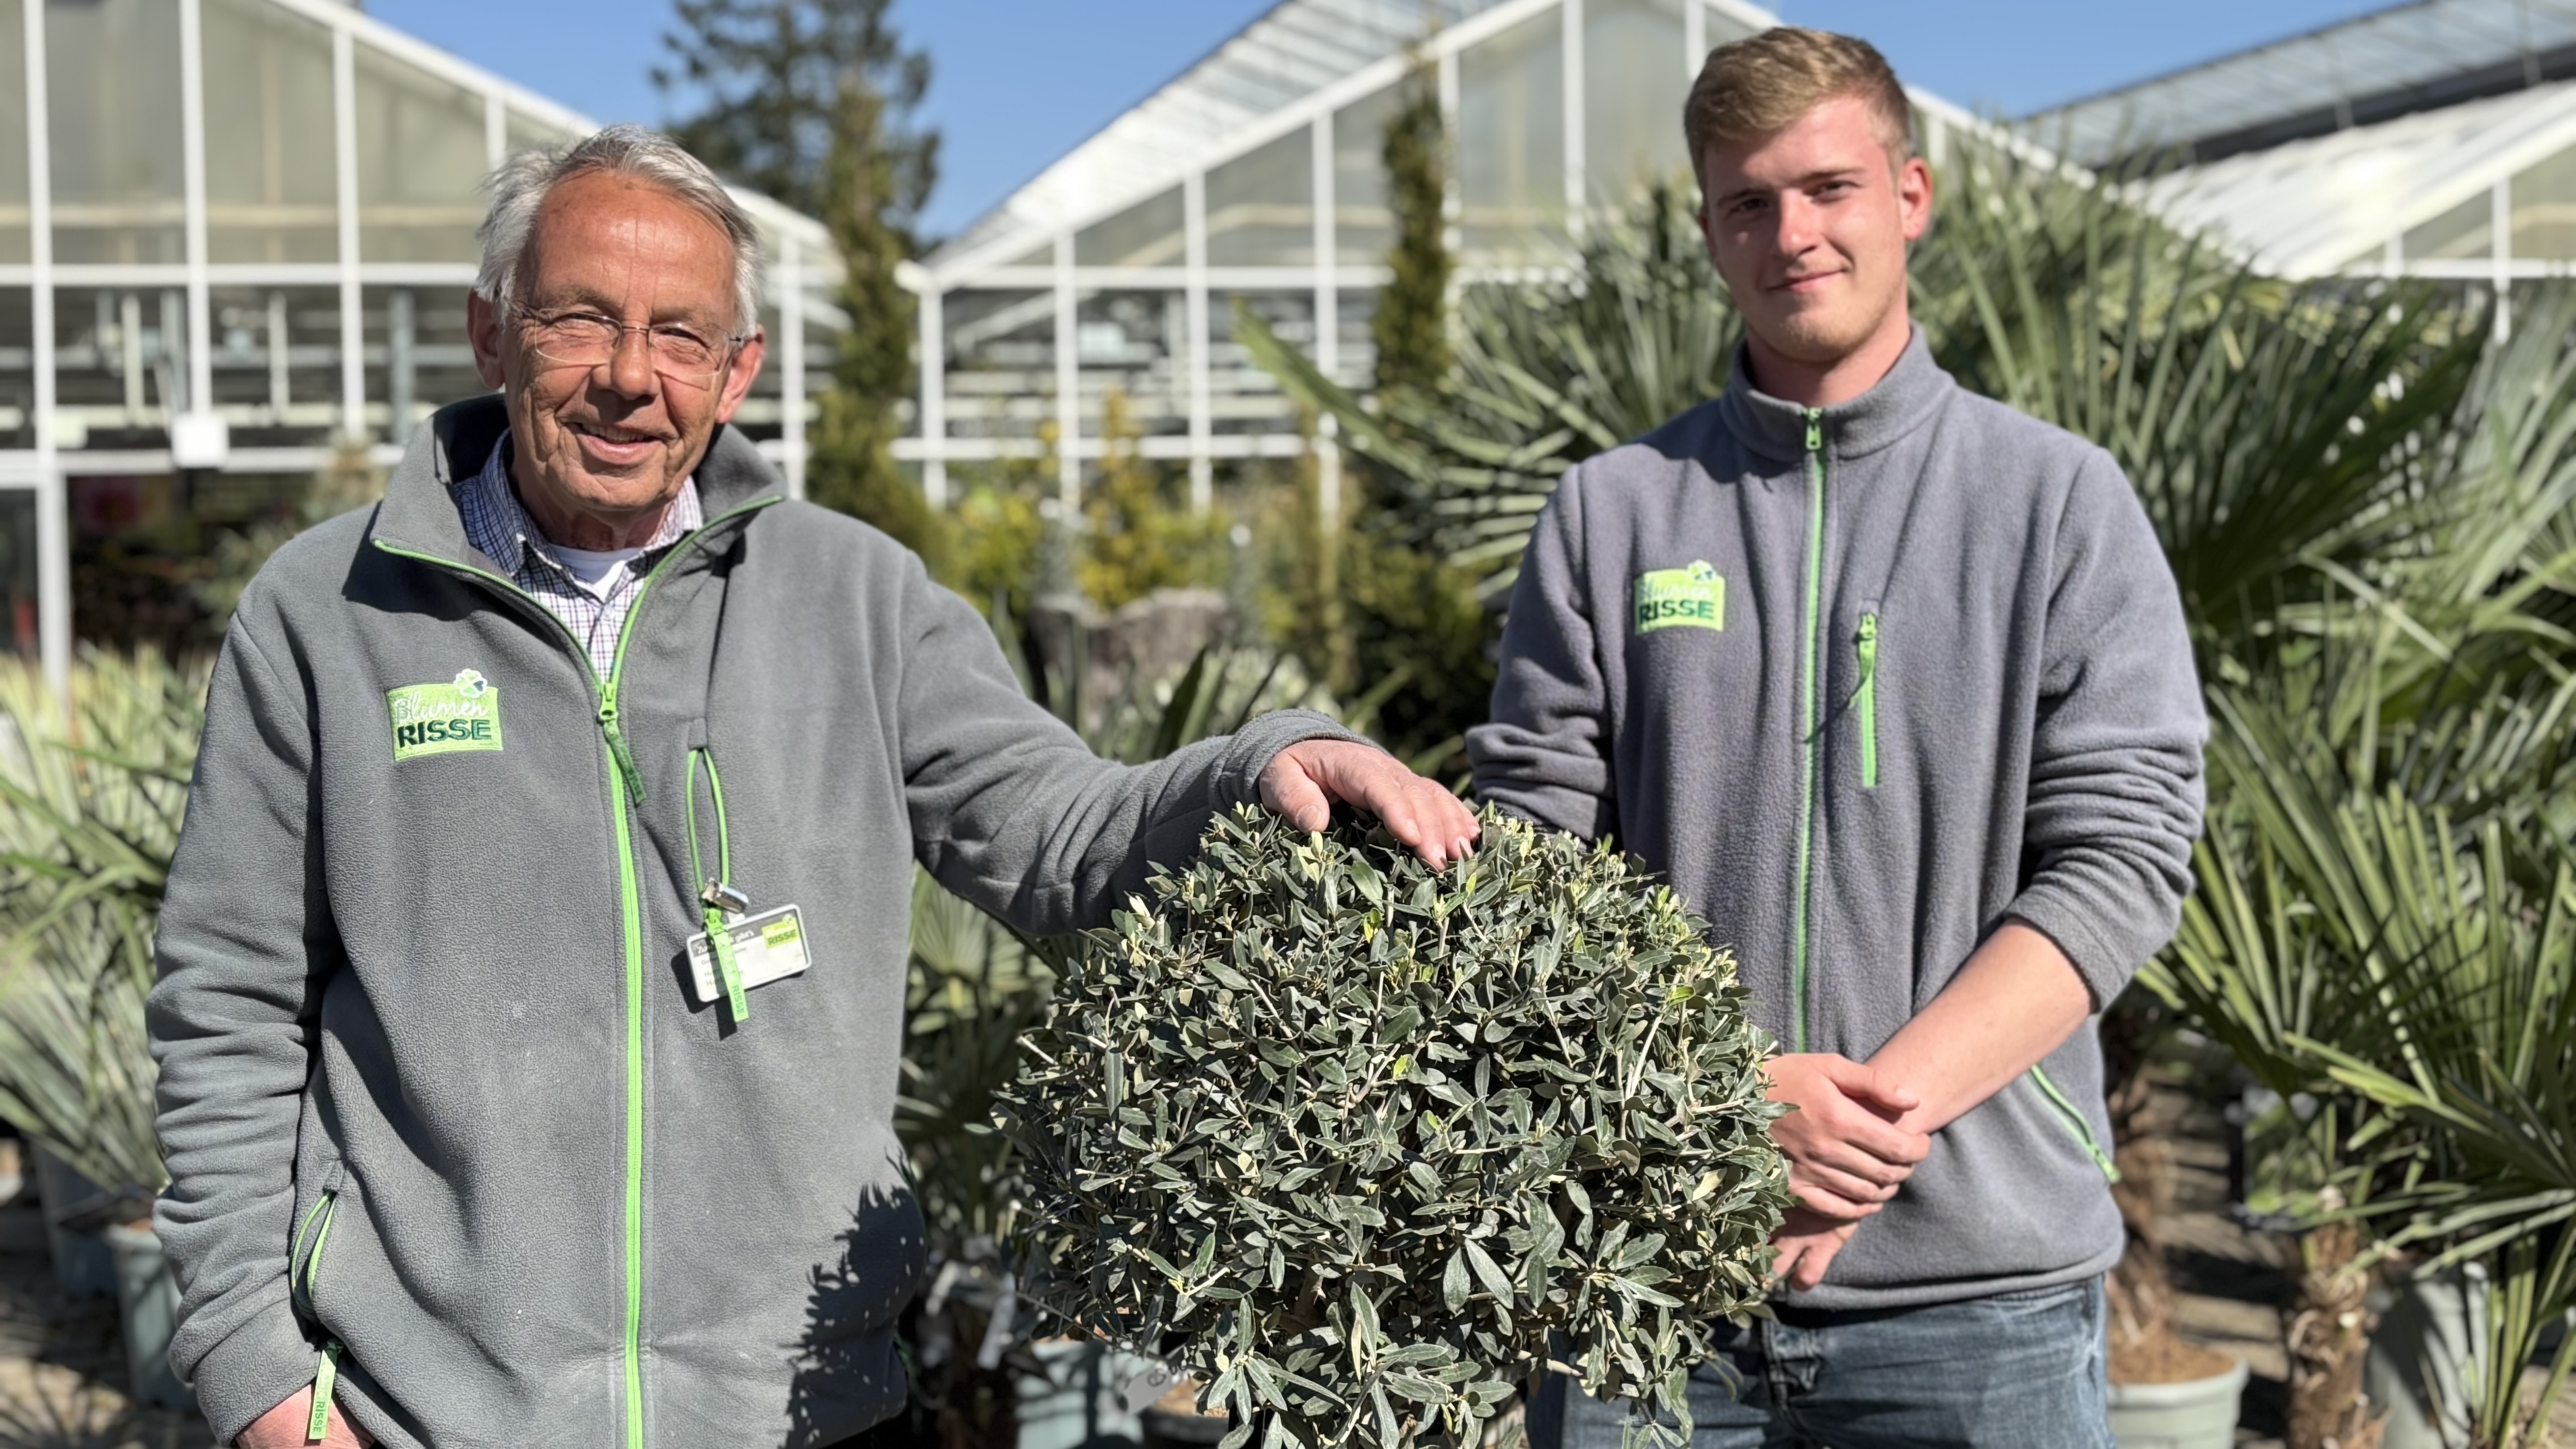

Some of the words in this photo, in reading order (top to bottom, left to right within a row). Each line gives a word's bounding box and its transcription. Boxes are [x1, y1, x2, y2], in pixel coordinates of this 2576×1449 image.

[1639, 599, 1715, 625] RISSE
[394, 691, 490, 725] Blumen
[397, 719, 492, 749] RISSE
[768, 929, 797, 945] RISSE
[732, 984, 745, 1014] RISSE
[313, 1401, 326, 1432] RISSE
